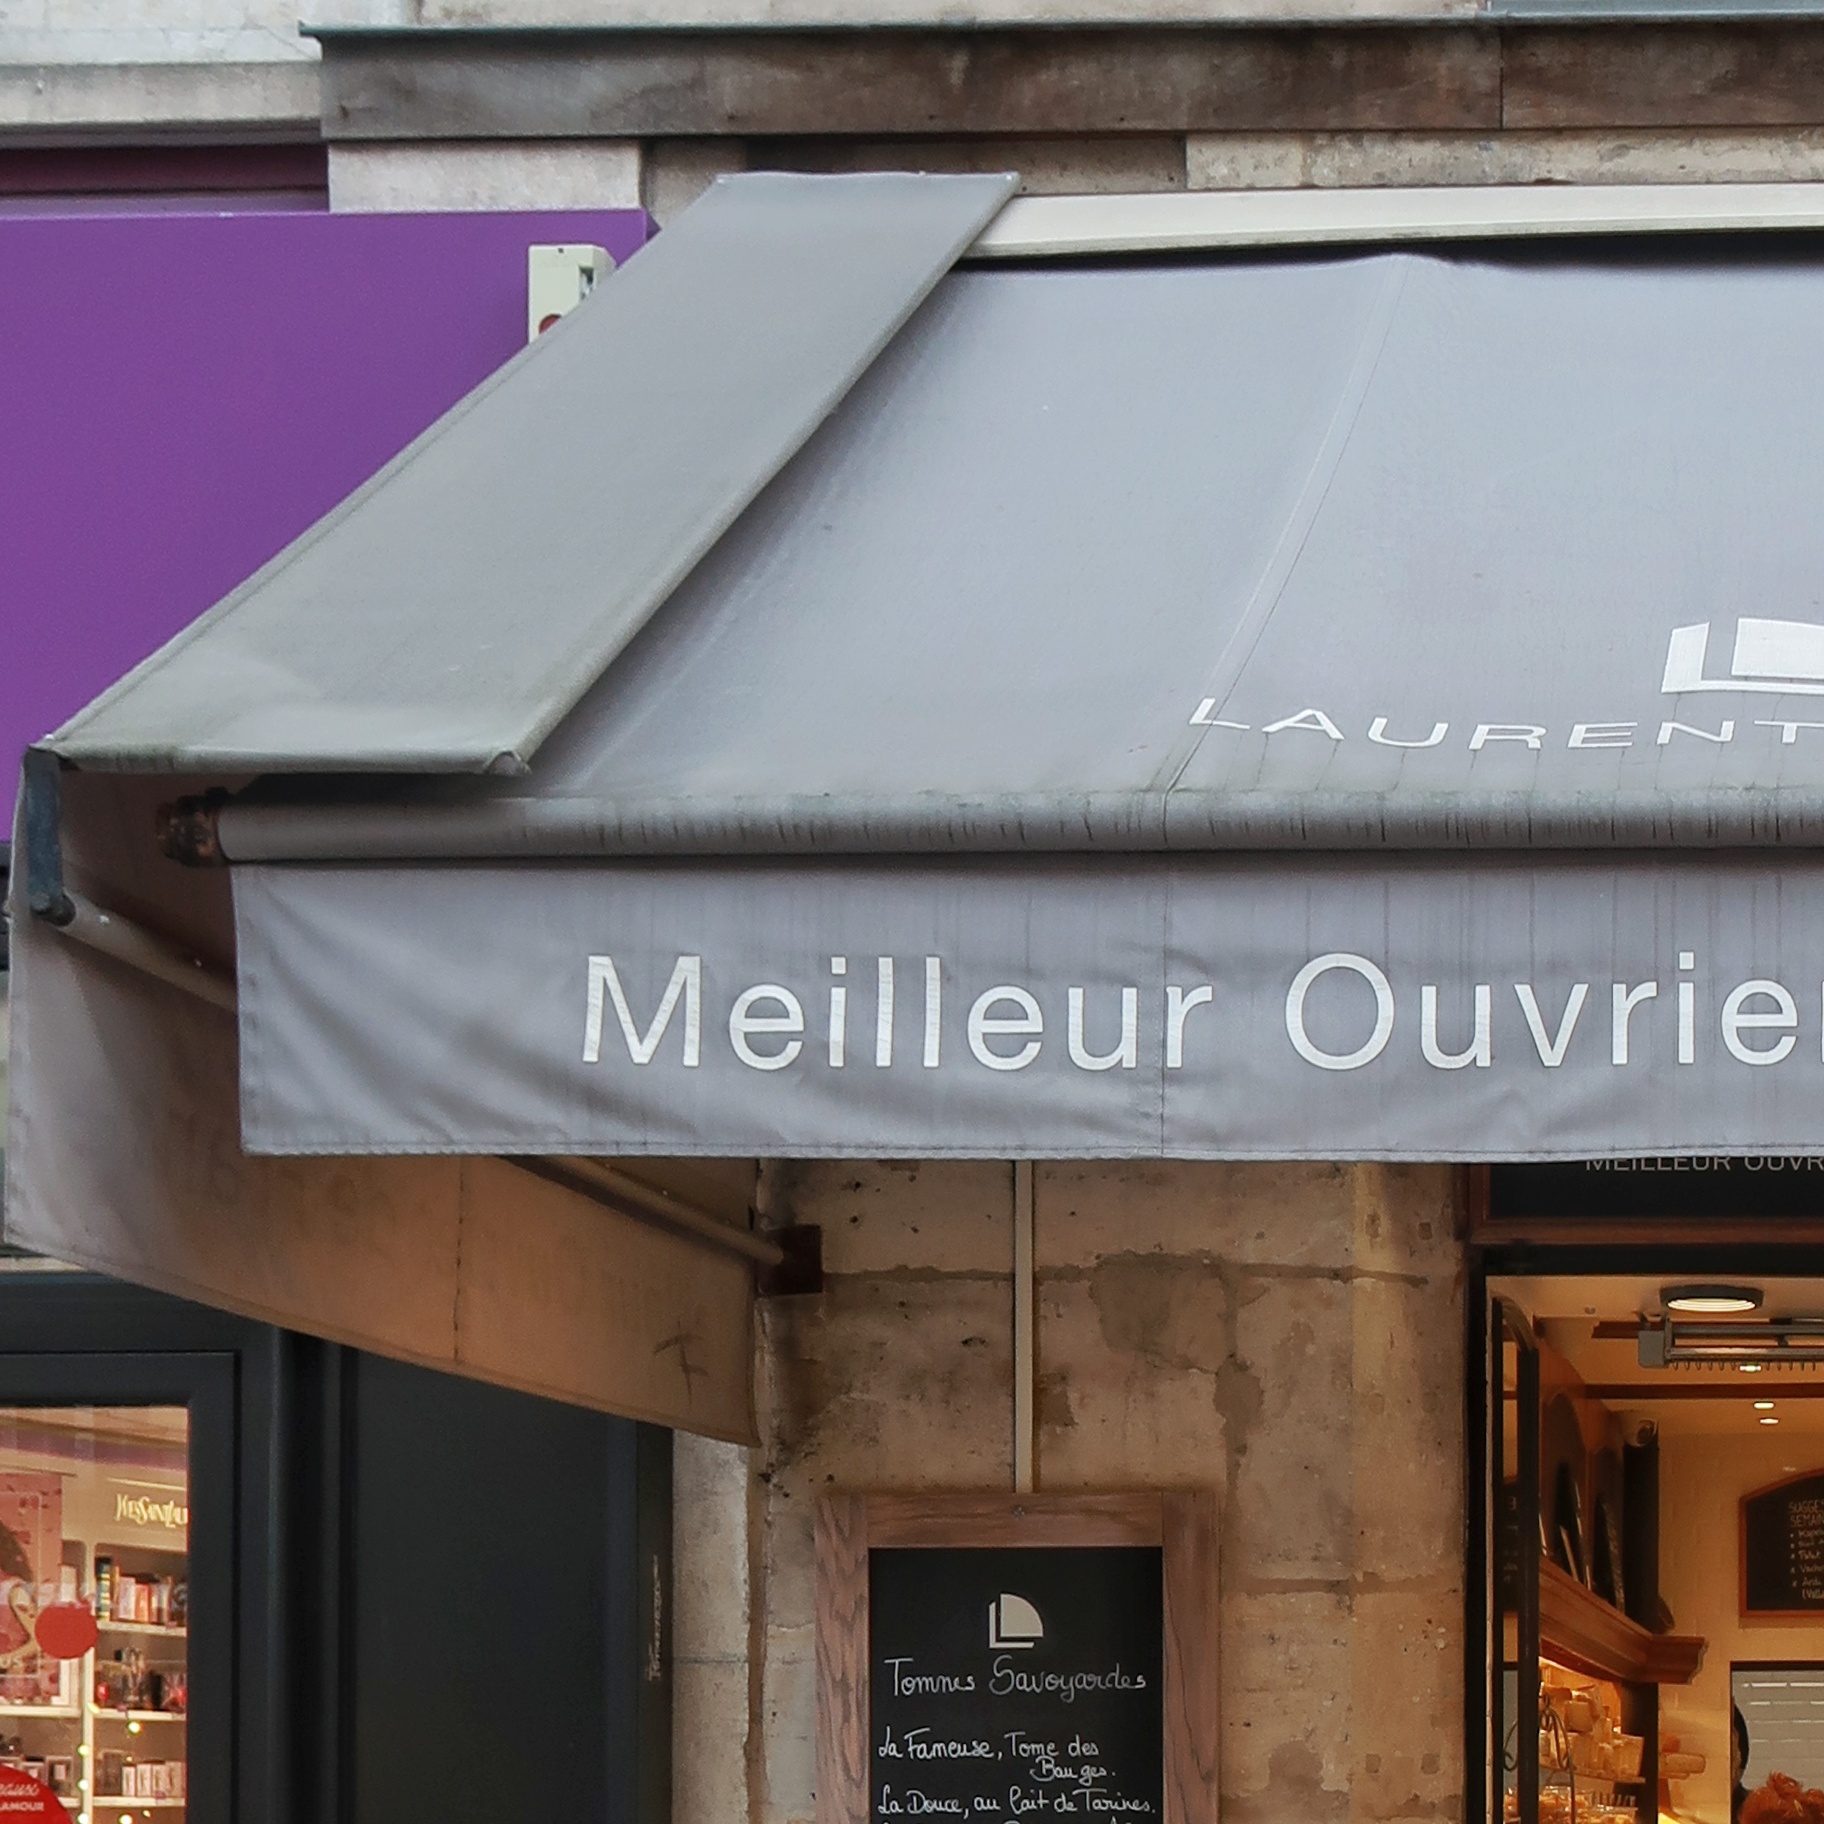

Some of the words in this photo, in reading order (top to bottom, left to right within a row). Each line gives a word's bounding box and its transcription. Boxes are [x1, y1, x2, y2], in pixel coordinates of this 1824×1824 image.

[582, 953, 1213, 1070] Meilleur
[988, 1654, 1147, 1702] Savoyardes
[878, 1725, 902, 1759] La
[1004, 1731, 1059, 1758] Tome
[1068, 1735, 1099, 1757] des
[877, 1783, 903, 1815] La
[974, 1795, 1001, 1812] au
[1054, 1790, 1078, 1812] de
